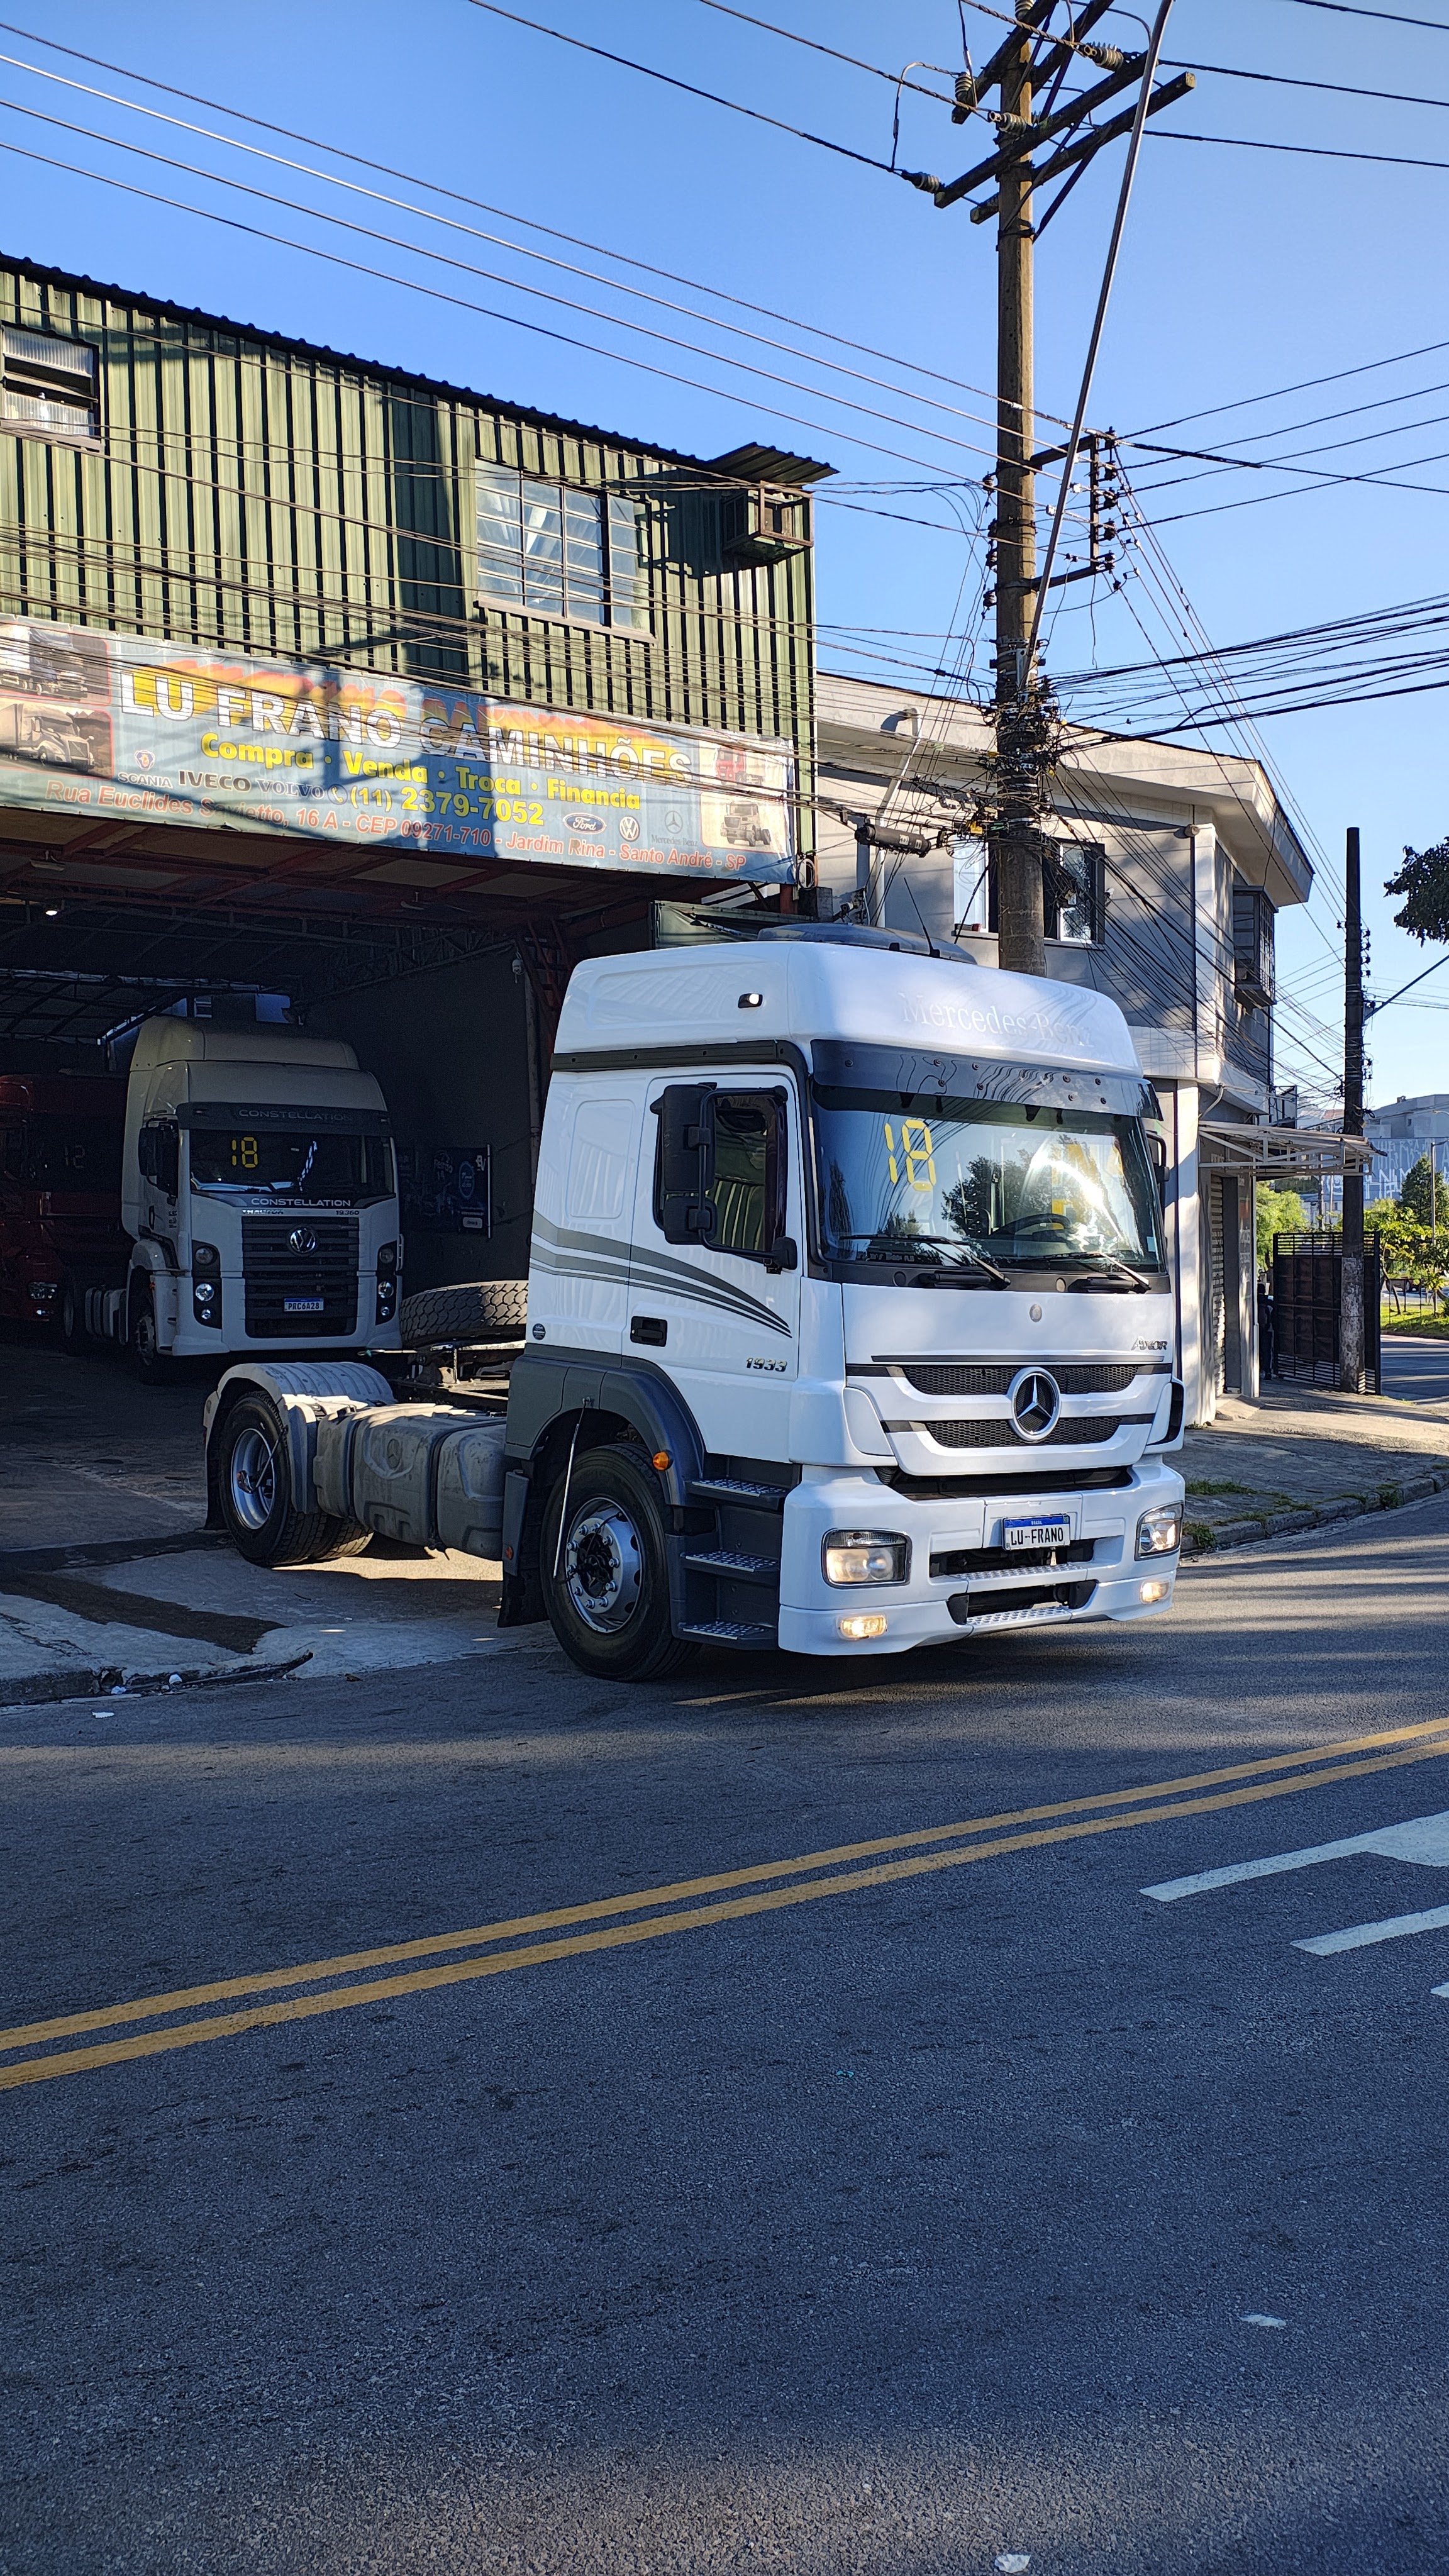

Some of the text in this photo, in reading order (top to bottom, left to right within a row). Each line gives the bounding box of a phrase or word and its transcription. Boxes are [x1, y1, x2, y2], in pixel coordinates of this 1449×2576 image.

[120, 671, 692, 788] LU FRANO CAMINHÕES
[118, 772, 173, 789] SCANIA
[178, 770, 250, 792] IVECO
[201, 733, 640, 810] Compra Venda Troca Financia
[256, 779, 324, 799] VOLVO
[350, 786, 544, 825] (11) 2379-7052
[45, 780, 91, 804] Rua
[98, 786, 193, 815] Euclides
[296, 808, 319, 828] 16
[323, 811, 338, 830] A
[356, 814, 397, 835] CEP
[401, 819, 491, 847] 09271-710
[506, 831, 564, 854] Jardim
[569, 838, 606, 859] Rina
[619, 843, 665, 865] Santo
[667, 848, 713, 869] André
[724, 853, 747, 871] SP
[572, 817, 597, 831] Ford
[239, 1109, 353, 1122] CONSTELLATION
[231, 1136, 258, 1168] 18
[884, 1119, 936, 1192] 18
[252, 1197, 351, 1206] CONSTELLATION
[287, 1302, 320, 1311] PRC6A28
[746, 1357, 788, 1372] 1933
[1010, 1526, 1063, 1546] LU-FRANO
